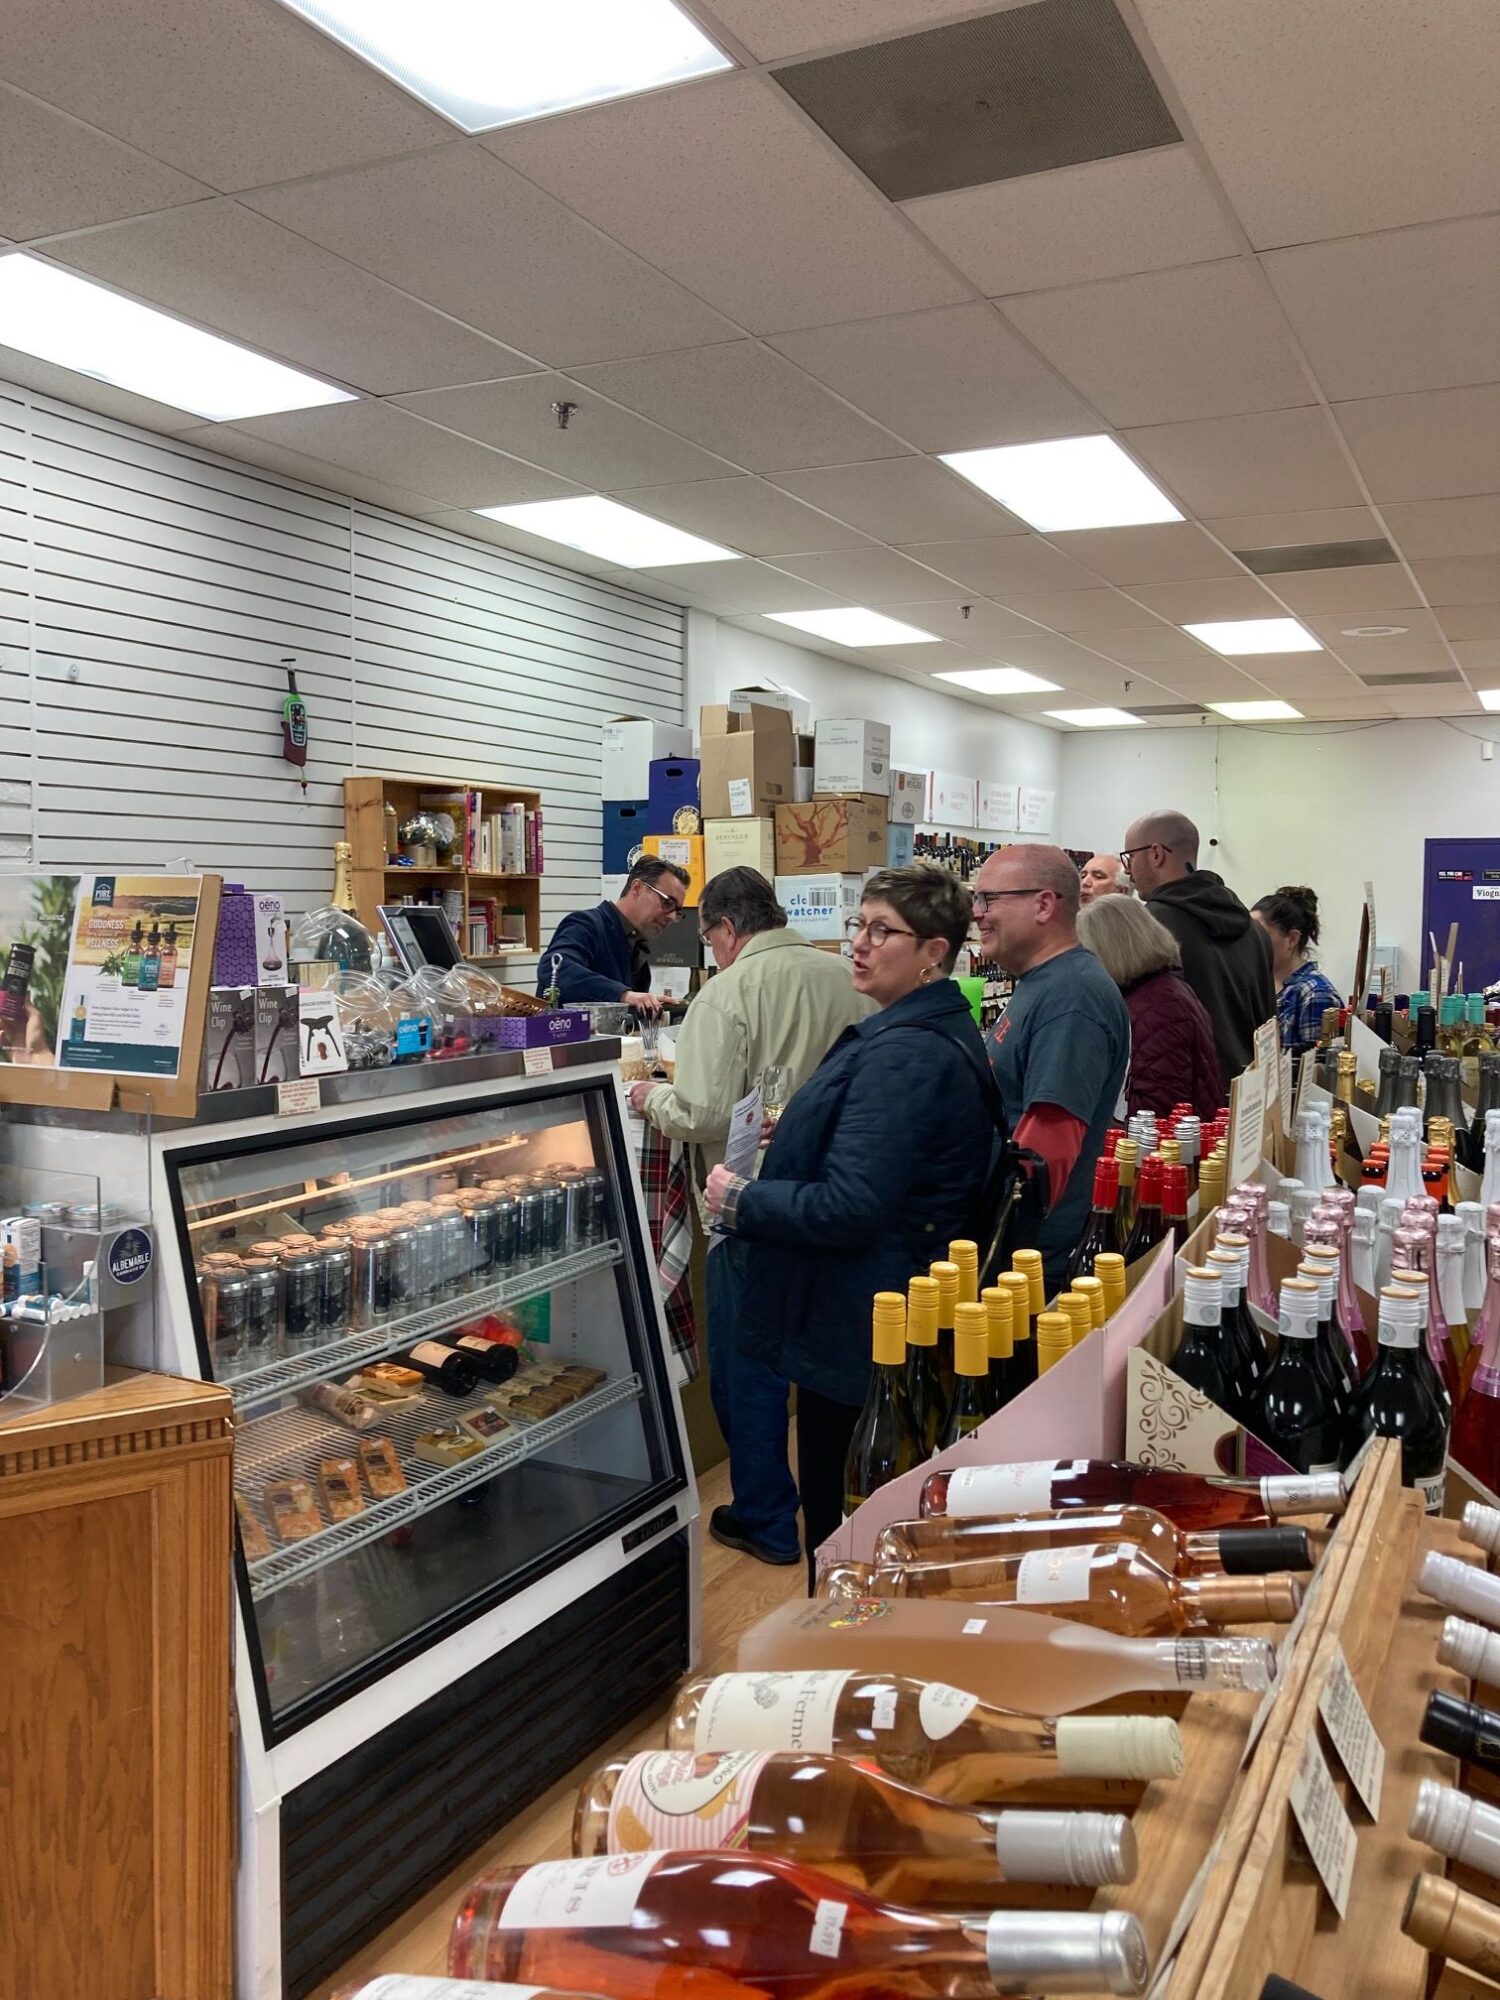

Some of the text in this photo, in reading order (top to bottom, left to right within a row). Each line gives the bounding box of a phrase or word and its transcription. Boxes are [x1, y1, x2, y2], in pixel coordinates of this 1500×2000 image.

[211, 1001, 233, 1013] Wine
[258, 998, 279, 1009] Wine
[211, 1016, 226, 1030] Clip
[258, 1012, 273, 1025] Clip
[112, 1252, 150, 1273] ALBEMARLE
[791, 1689, 817, 1750] Ferme
